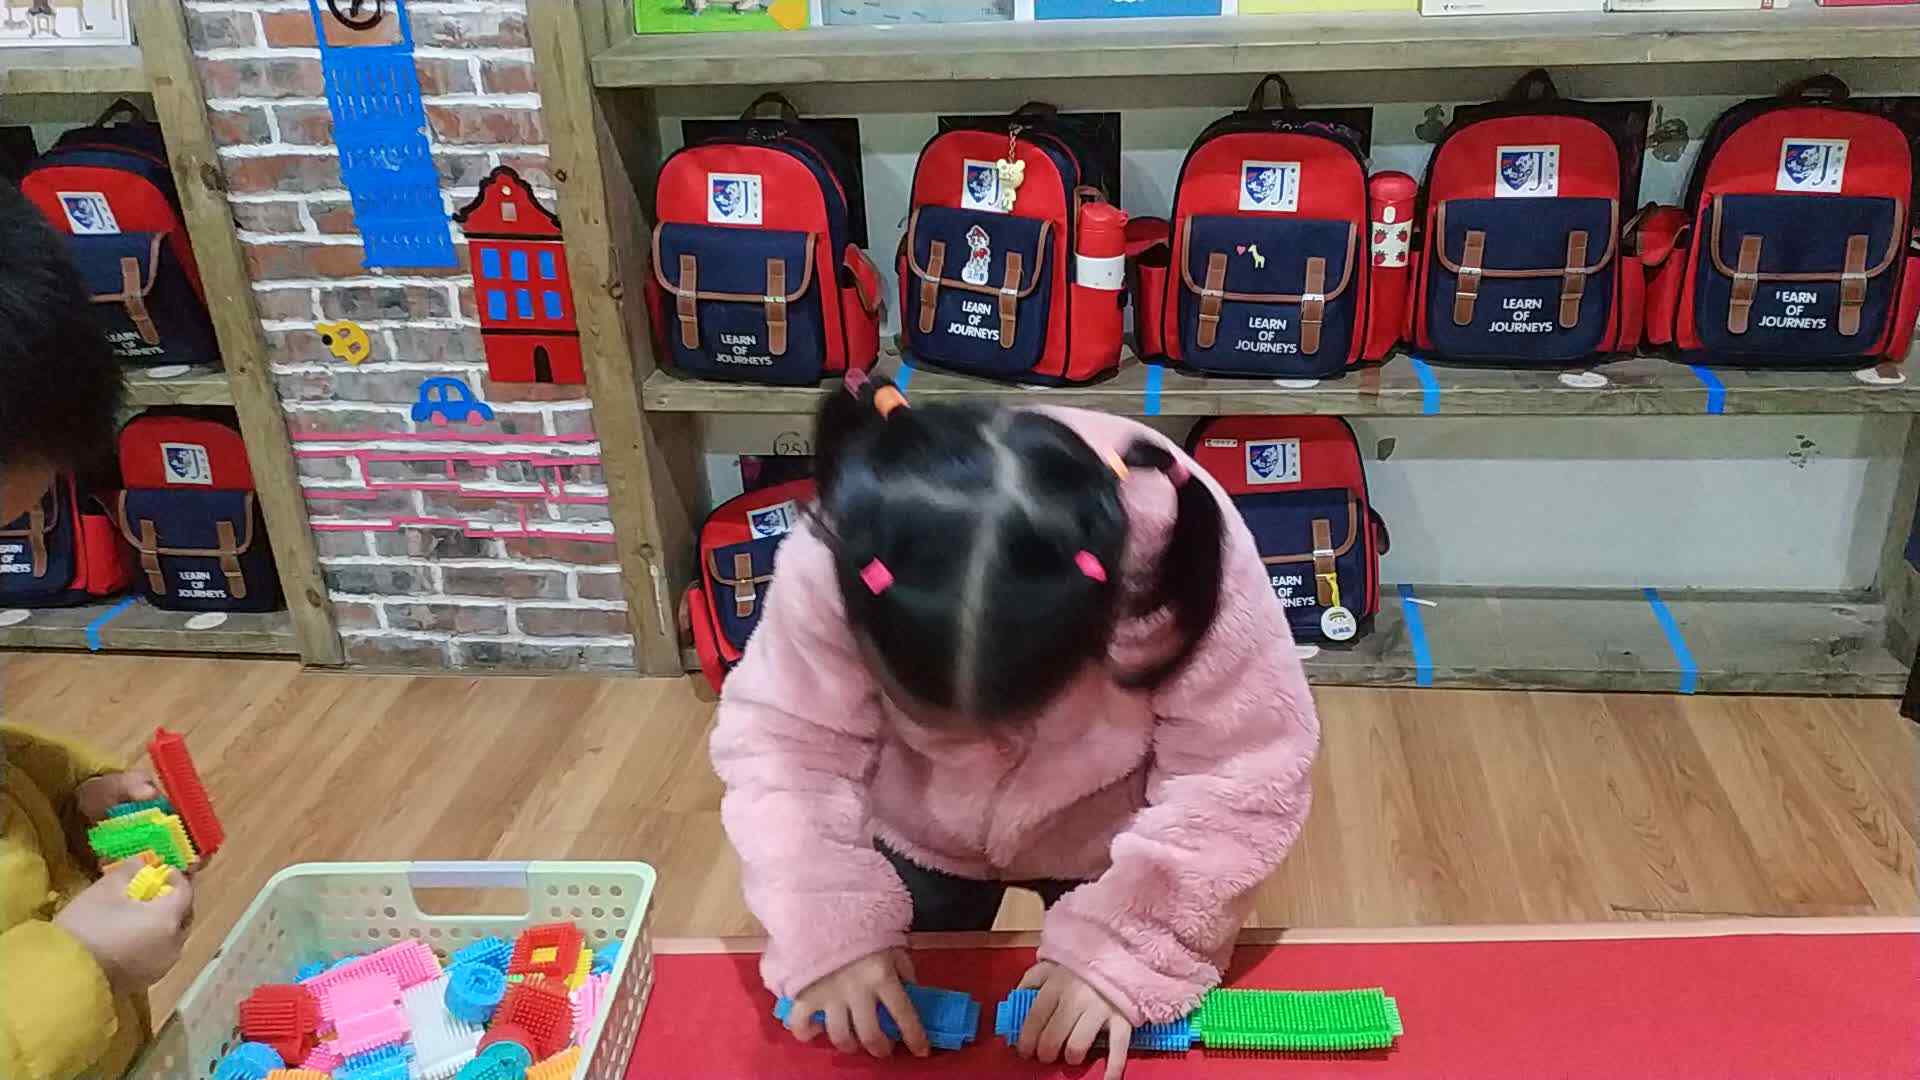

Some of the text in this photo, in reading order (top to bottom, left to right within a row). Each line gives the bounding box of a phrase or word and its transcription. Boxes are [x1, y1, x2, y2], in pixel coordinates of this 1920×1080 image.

[962, 300, 991, 315] LEARN
[1503, 298, 1542, 309] LEARN
[1513, 311, 1531, 321] OF
[1785, 305, 1805, 316] OF
[968, 314, 982, 325] OF
[1249, 317, 1287, 330] LEARN
[1758, 315, 1827, 329] JOURNEYS
[947, 322, 1000, 341] JOURNEYS
[1488, 321, 1553, 332] JOURNEYS
[720, 333, 756, 345] LEARN
[1258, 331, 1275, 341] OF
[732, 345, 748, 355] OF
[1235, 340, 1297, 354] JOURNEYS
[716, 353, 773, 365] JOURNEYS
[179, 571, 210, 580] LEARN
[1270, 576, 1302, 586] EARN
[1278, 587, 1292, 597] OF
[1281, 596, 1316, 607] RNEYS
